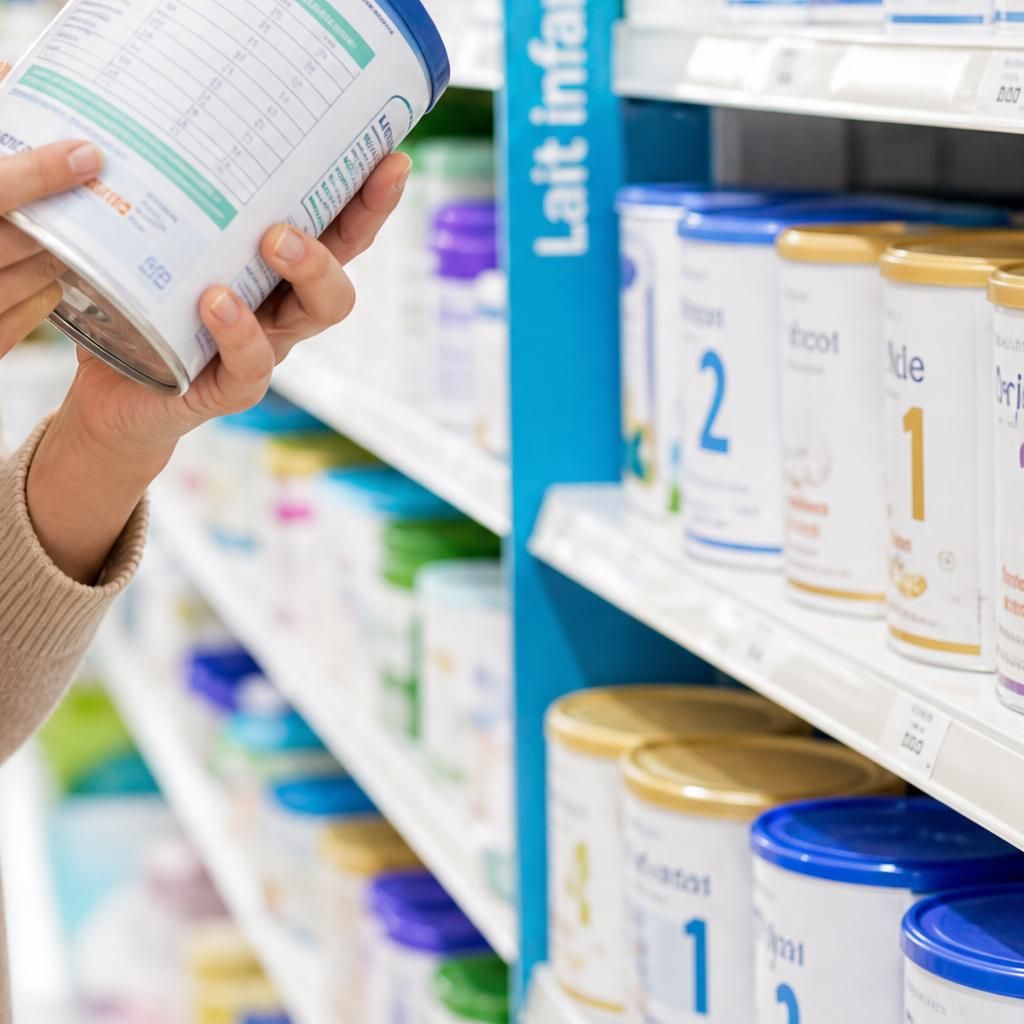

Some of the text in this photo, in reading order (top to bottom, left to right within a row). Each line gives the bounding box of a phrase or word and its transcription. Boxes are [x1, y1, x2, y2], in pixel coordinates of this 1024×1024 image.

[532, 135, 589, 257] Lait
[699, 348, 730, 454] 2
[902, 406, 925, 522] 1
[683, 917, 708, 1016] 1
